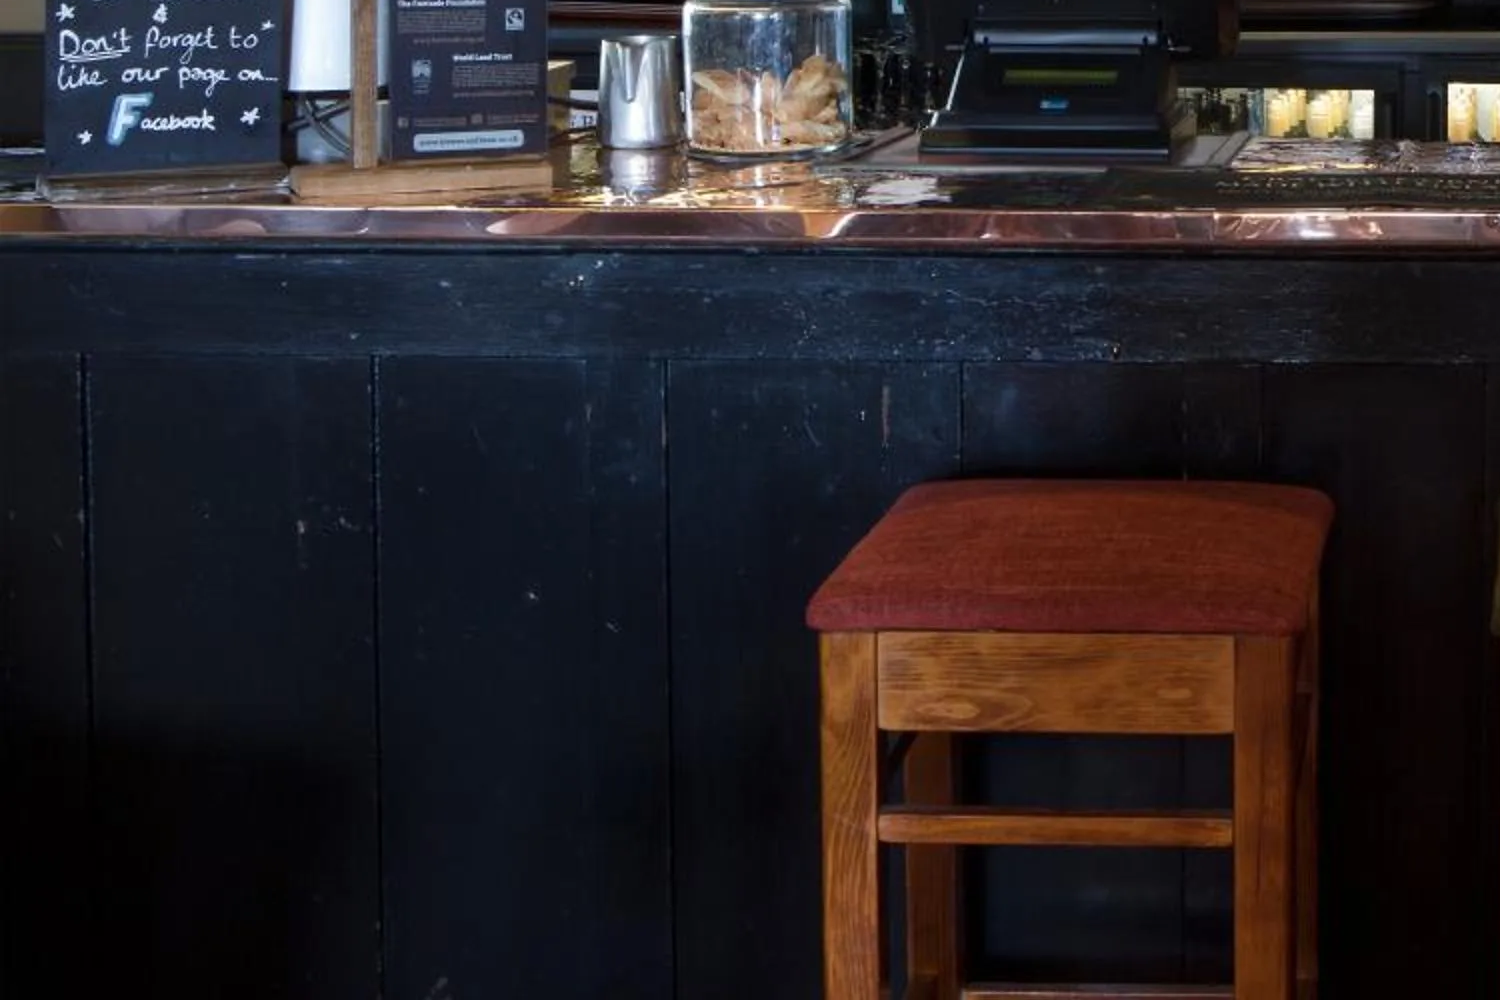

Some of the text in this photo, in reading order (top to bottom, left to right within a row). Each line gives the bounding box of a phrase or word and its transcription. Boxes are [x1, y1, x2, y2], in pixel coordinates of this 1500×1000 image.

[58, 25, 259, 64] Don't forget to
[57, 63, 107, 91] like
[120, 66, 170, 83] our
[177, 65, 231, 98] page
[106, 92, 217, 147] Facebook
